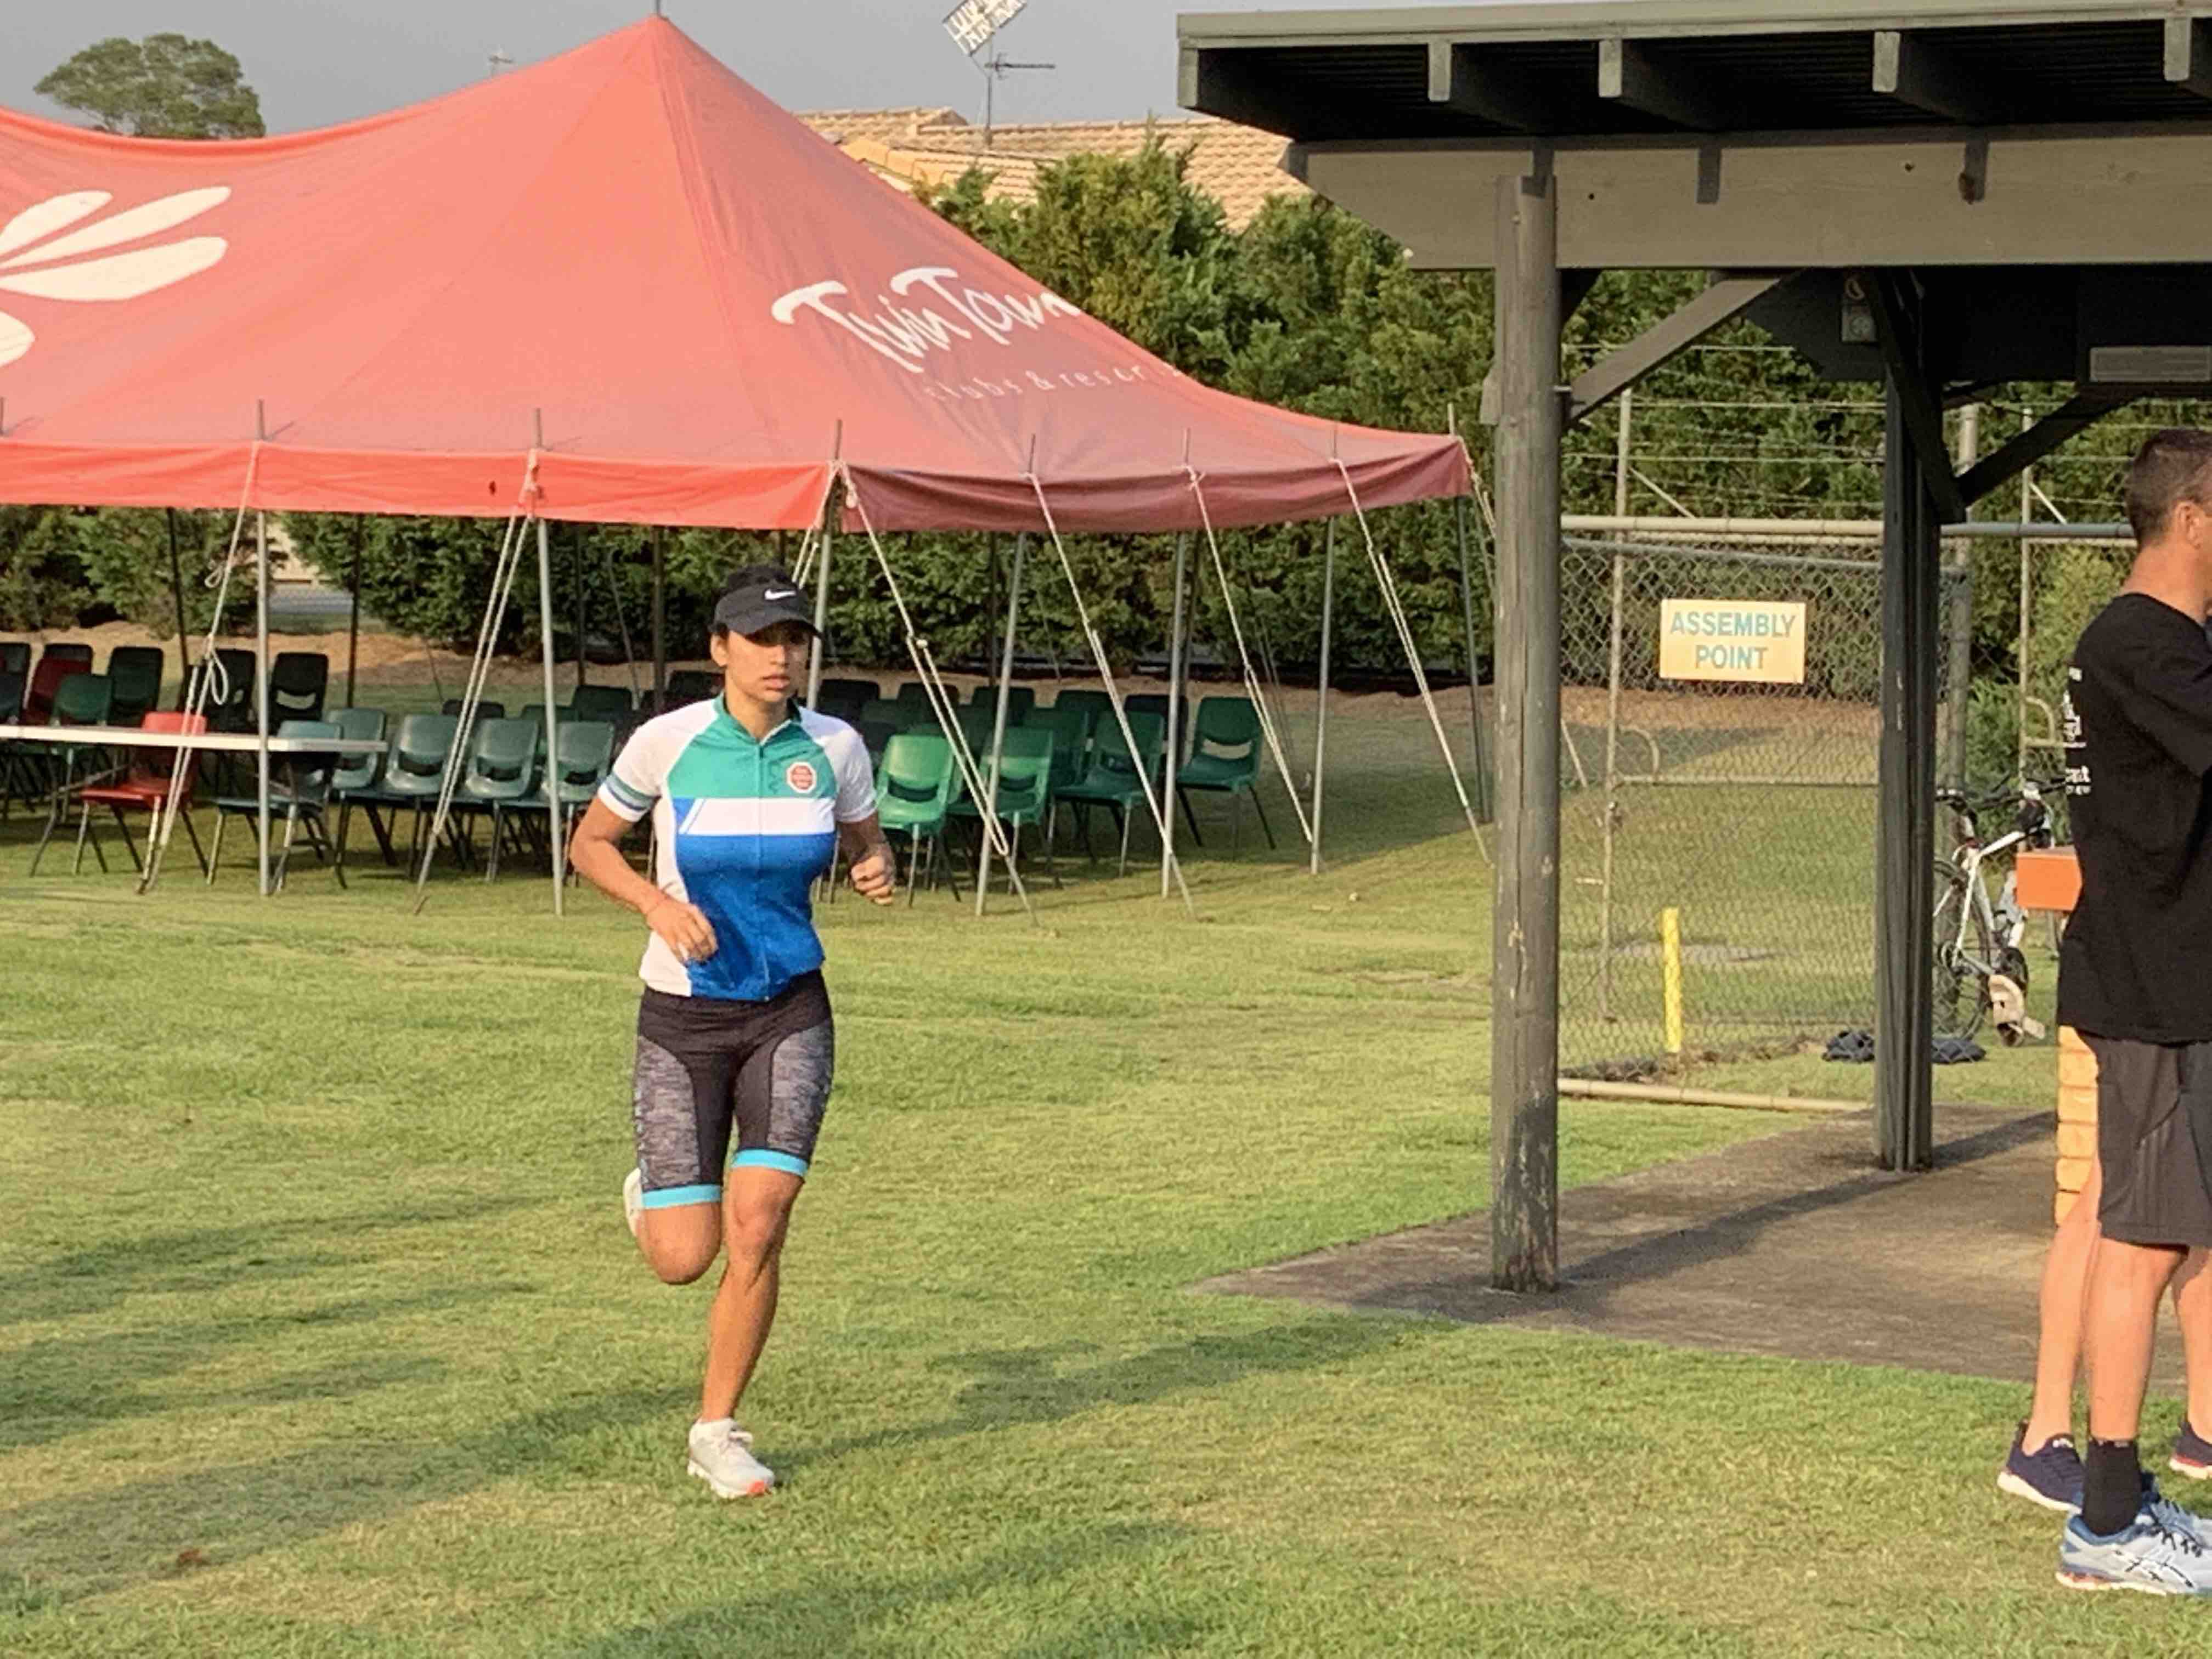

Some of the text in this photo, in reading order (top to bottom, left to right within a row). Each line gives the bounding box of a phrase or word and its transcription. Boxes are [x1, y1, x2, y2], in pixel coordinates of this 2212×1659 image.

[771, 281, 972, 373] Twin
[923, 377, 1023, 399] clubs
[1025, 370, 1056, 391] &
[1670, 611, 1796, 637] ASSEMBLY
[1695, 644, 1768, 669] POINT
